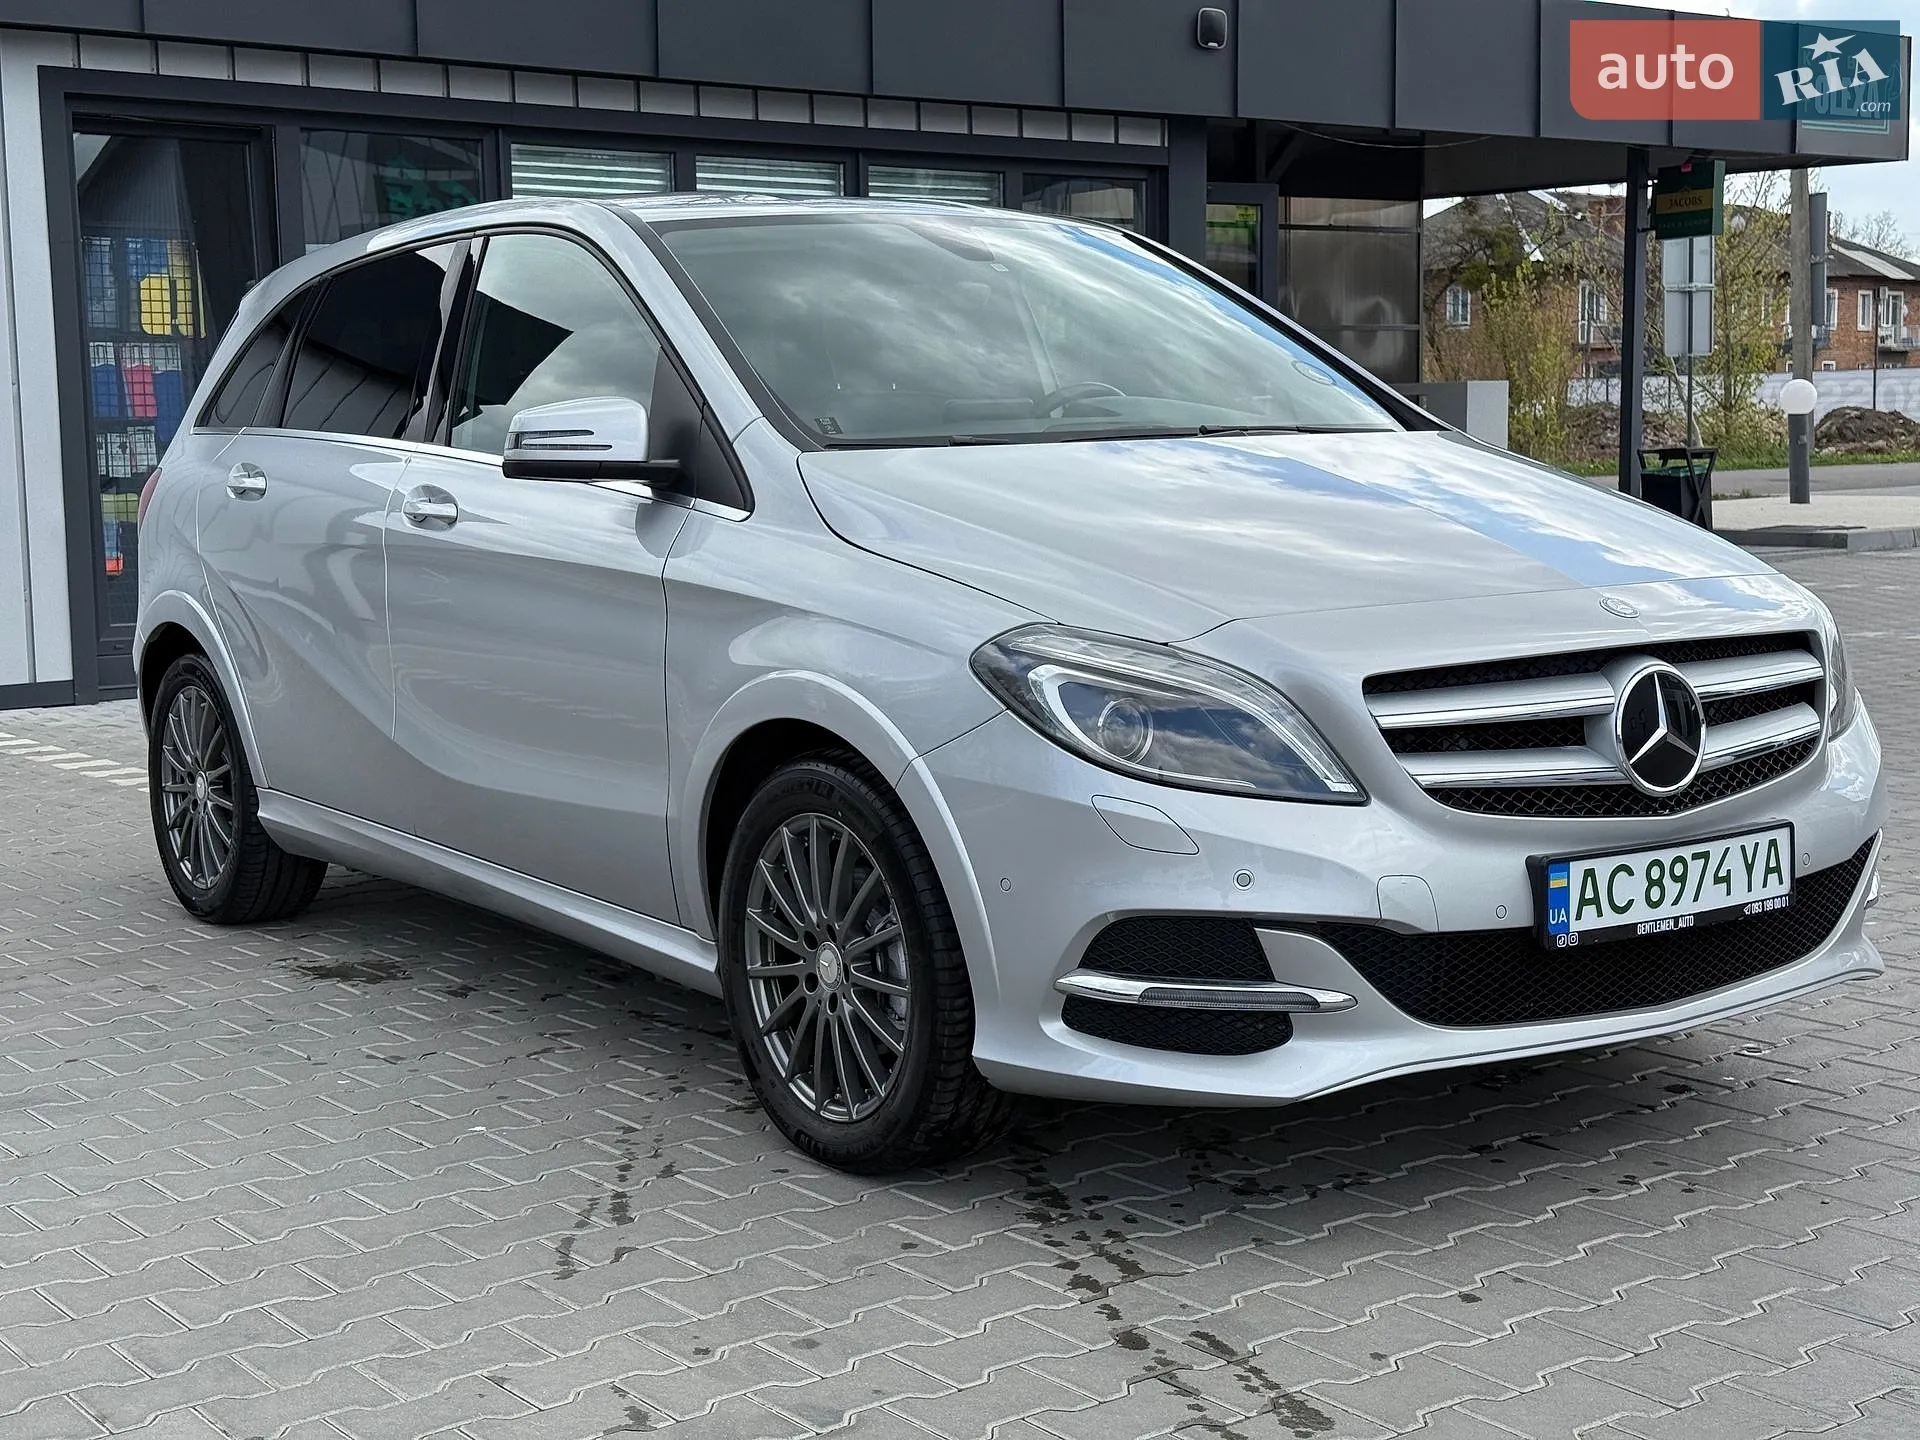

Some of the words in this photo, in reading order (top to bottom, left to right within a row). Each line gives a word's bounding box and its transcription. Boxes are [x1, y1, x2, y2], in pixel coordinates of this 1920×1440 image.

[1667, 195, 1704, 209] JACOBS
[1575, 863, 1635, 921] AC
[1644, 846, 1732, 910] 8974
[1741, 838, 1784, 892] YA
[1549, 908, 1568, 925] UA
[1752, 902, 1763, 914] 093
[1637, 915, 1694, 935] GENTLEMEN_AUTO
